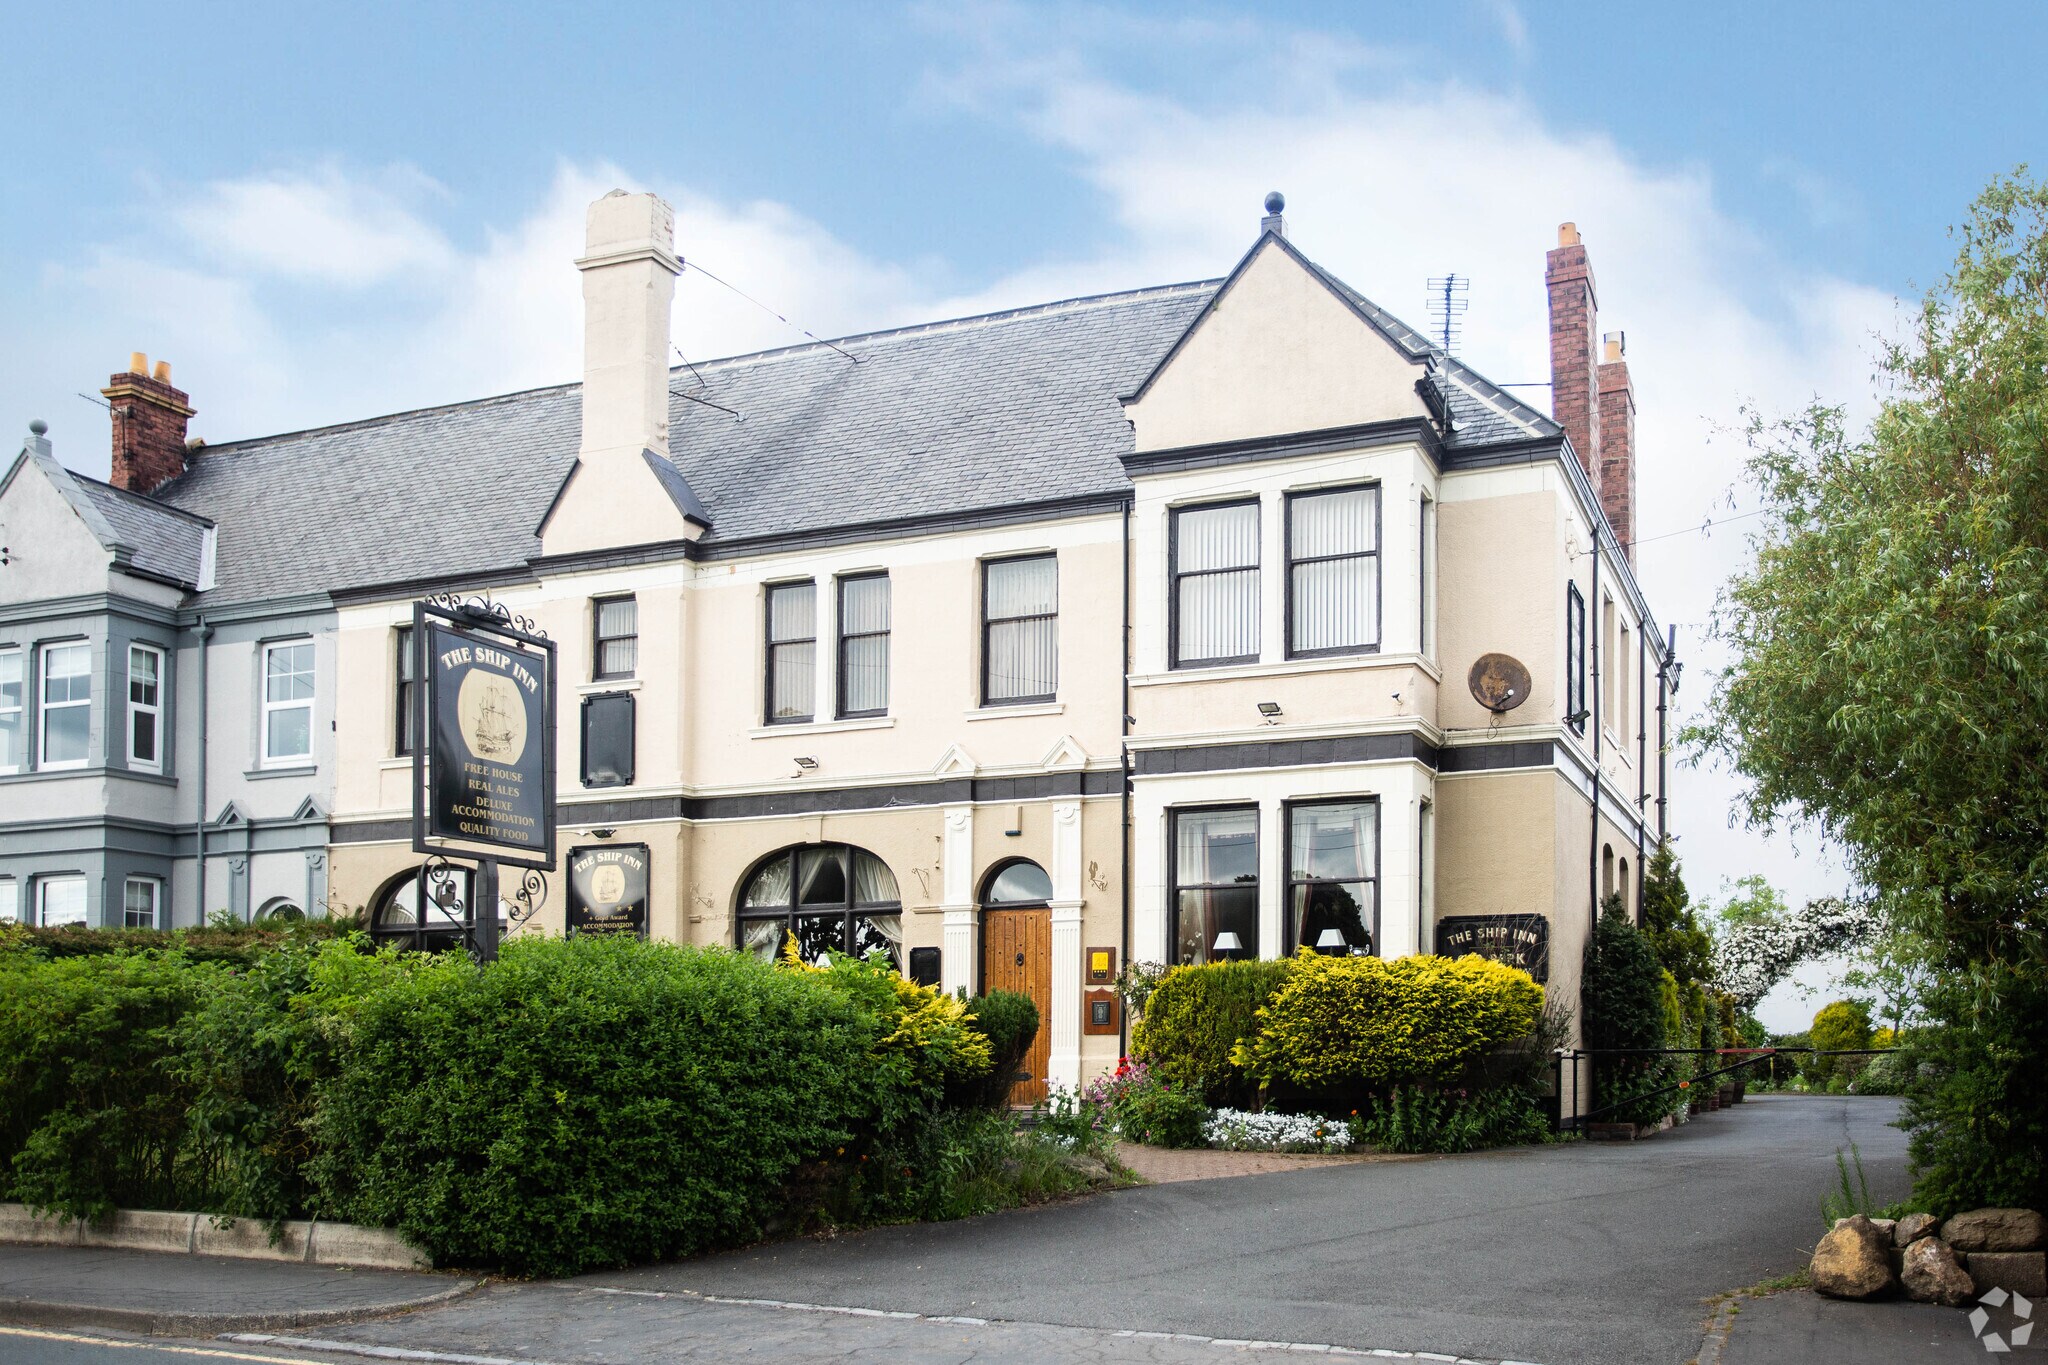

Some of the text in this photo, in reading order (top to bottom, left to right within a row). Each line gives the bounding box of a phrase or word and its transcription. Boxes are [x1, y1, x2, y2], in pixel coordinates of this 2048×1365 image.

[441, 647, 538, 694] THE SHIP INN
[464, 762, 523, 783] FREE HOUSE
[468, 779, 520, 797] REAL ALES
[476, 796, 513, 811] DELUXE
[451, 804, 535, 827] ACCOMMODATION
[459, 821, 529, 841] QUALITY FOOD
[574, 852, 643, 873] THE SHIP INN
[1447, 927, 1537, 946] THE SHIP INN
